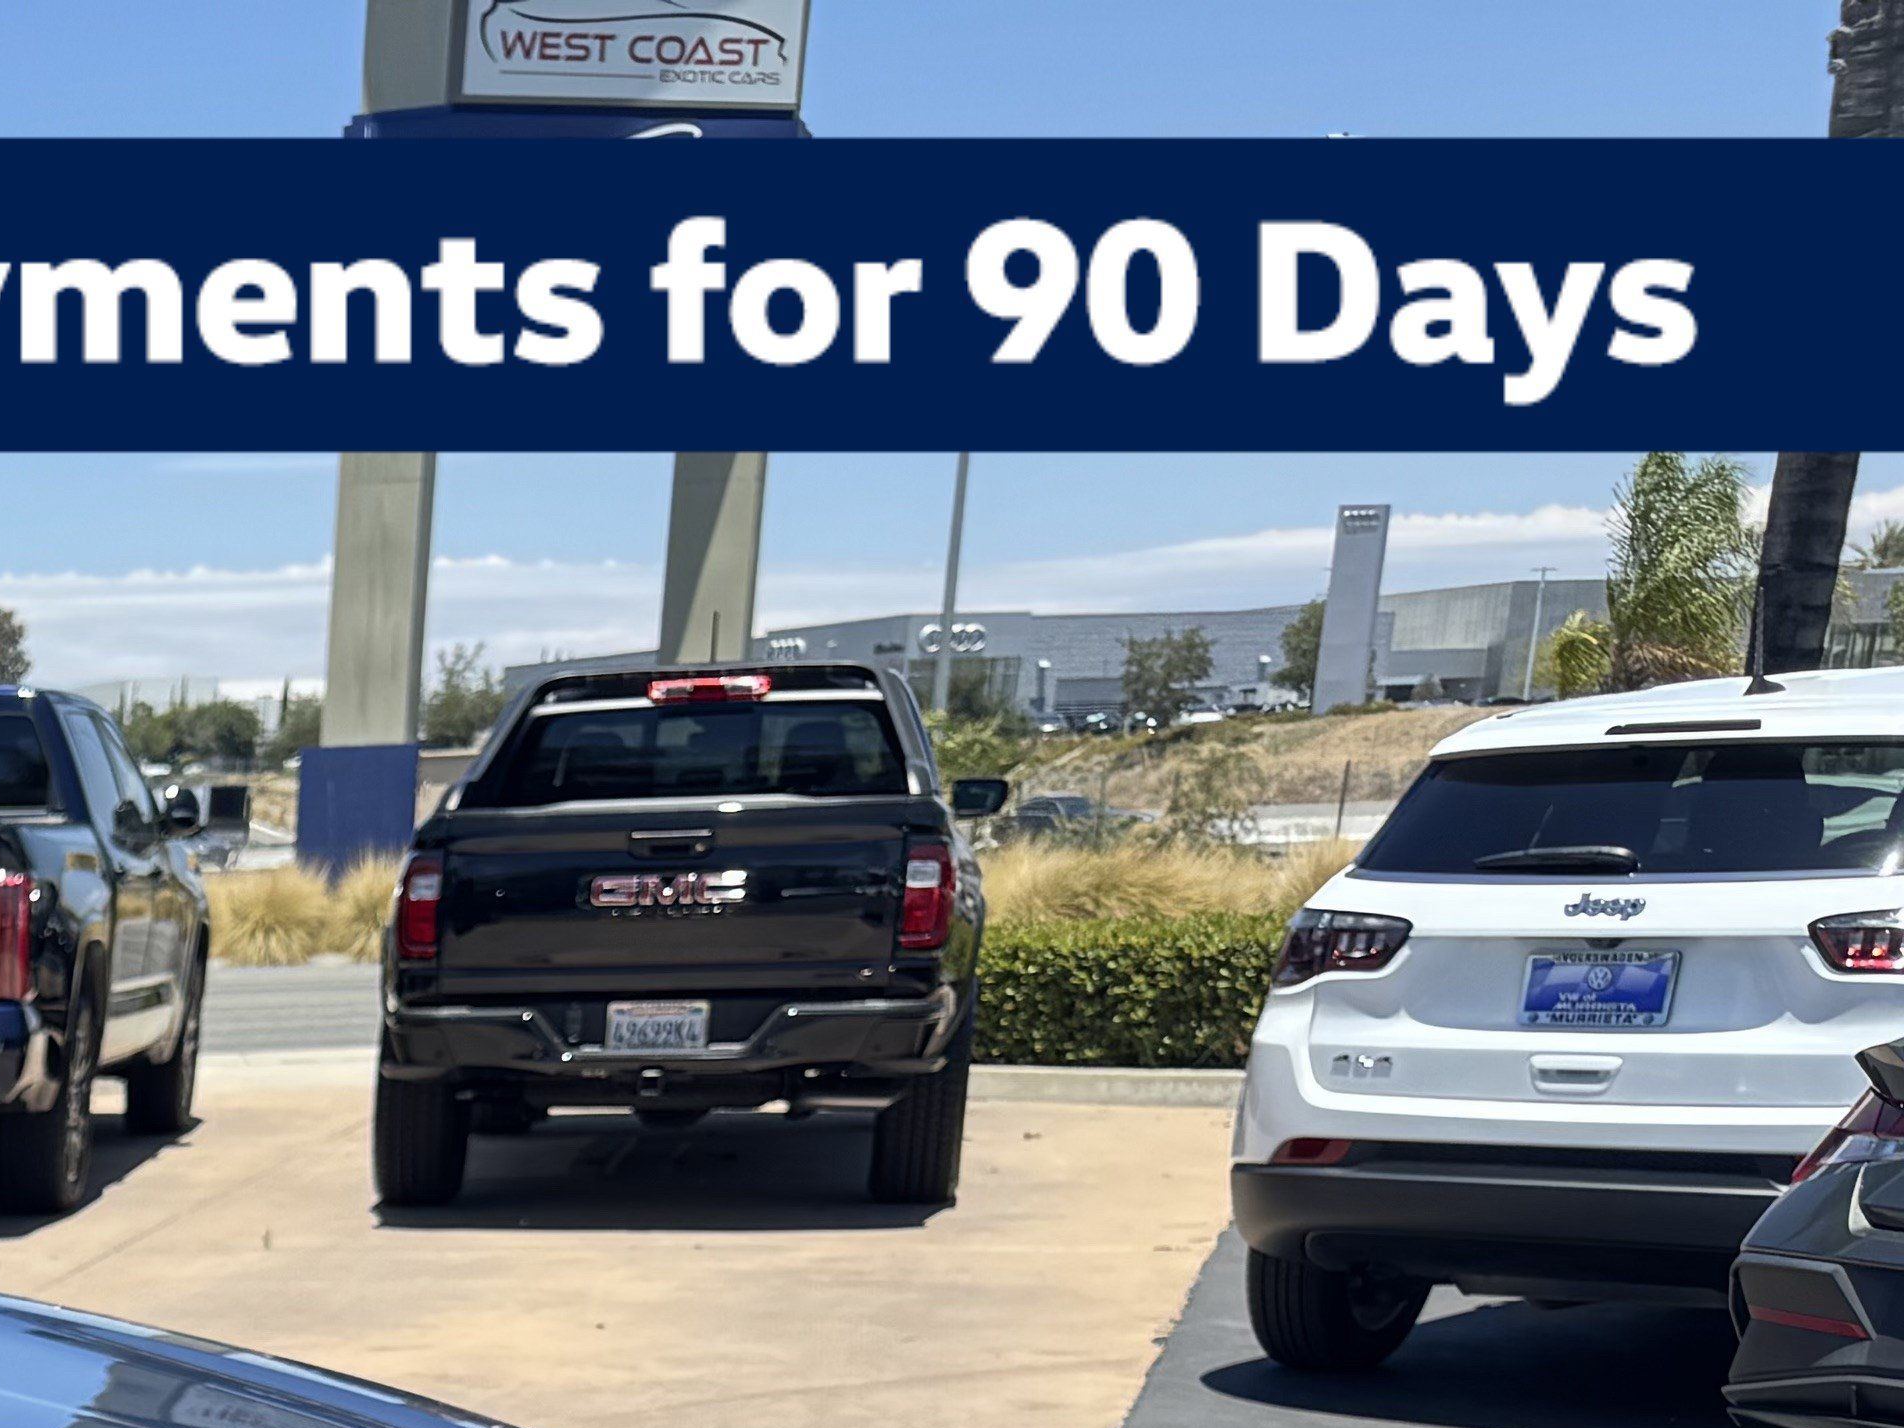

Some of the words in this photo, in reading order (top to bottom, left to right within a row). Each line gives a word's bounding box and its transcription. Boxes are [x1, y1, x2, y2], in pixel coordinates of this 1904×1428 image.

[500, 29, 616, 63] WEST
[627, 35, 770, 67] COAST
[659, 69, 725, 84] EXOTIC
[728, 71, 782, 86] CARS
[590, 870, 748, 907] GMC
[1564, 892, 1646, 921] Jeep
